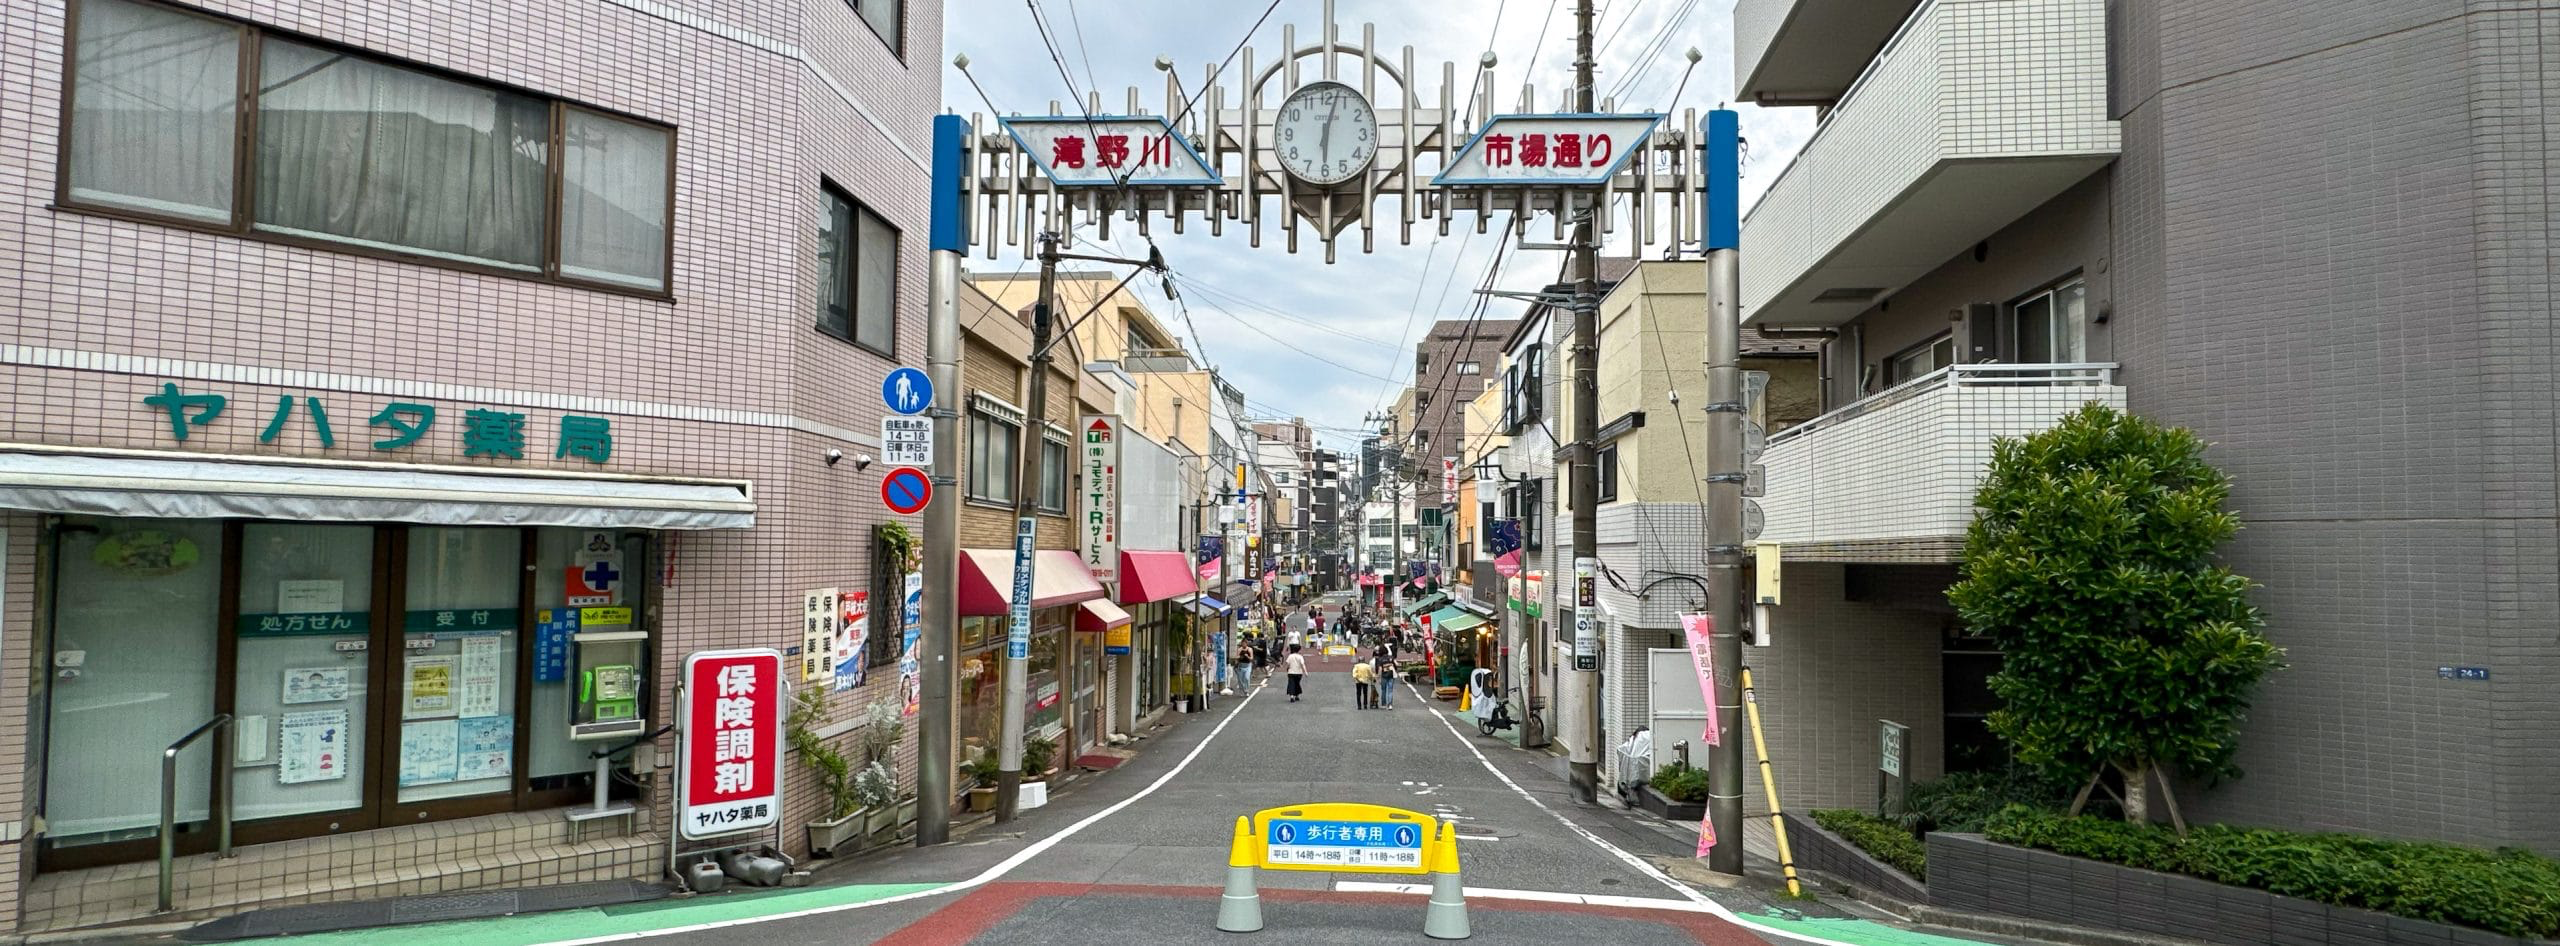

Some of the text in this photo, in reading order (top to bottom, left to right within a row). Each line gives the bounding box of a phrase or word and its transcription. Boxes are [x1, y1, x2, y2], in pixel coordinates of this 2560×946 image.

[1288, 109, 1300, 122] 10
[1353, 109, 1362, 122] 2
[1284, 128, 1294, 141] 9
[1358, 128, 1368, 141] 3
[1052, 135, 1171, 169] 滝野川
[1289, 146, 1299, 160] 8
[1351, 146, 1362, 160] 4
[1484, 133, 1612, 168] 市場通り
[1303, 160, 1313, 173] 7
[1320, 163, 1330, 177] 6
[1338, 160, 1348, 173] 5
[144, 382, 613, 463] ヤハタ薬局
[1249, 550, 1259, 578] Seria
[260, 615, 351, 631] 処方せん
[436, 611, 489, 626] 受付
[807, 596, 818, 674] 保険薬局
[822, 596, 833, 673] 保険薬局
[714, 664, 756, 795] 保険調剤
[697, 804, 768, 827] ヤハタ薬局
[1307, 825, 1383, 842] 歩行者専用
[1273, 850, 1289, 858] 平日
